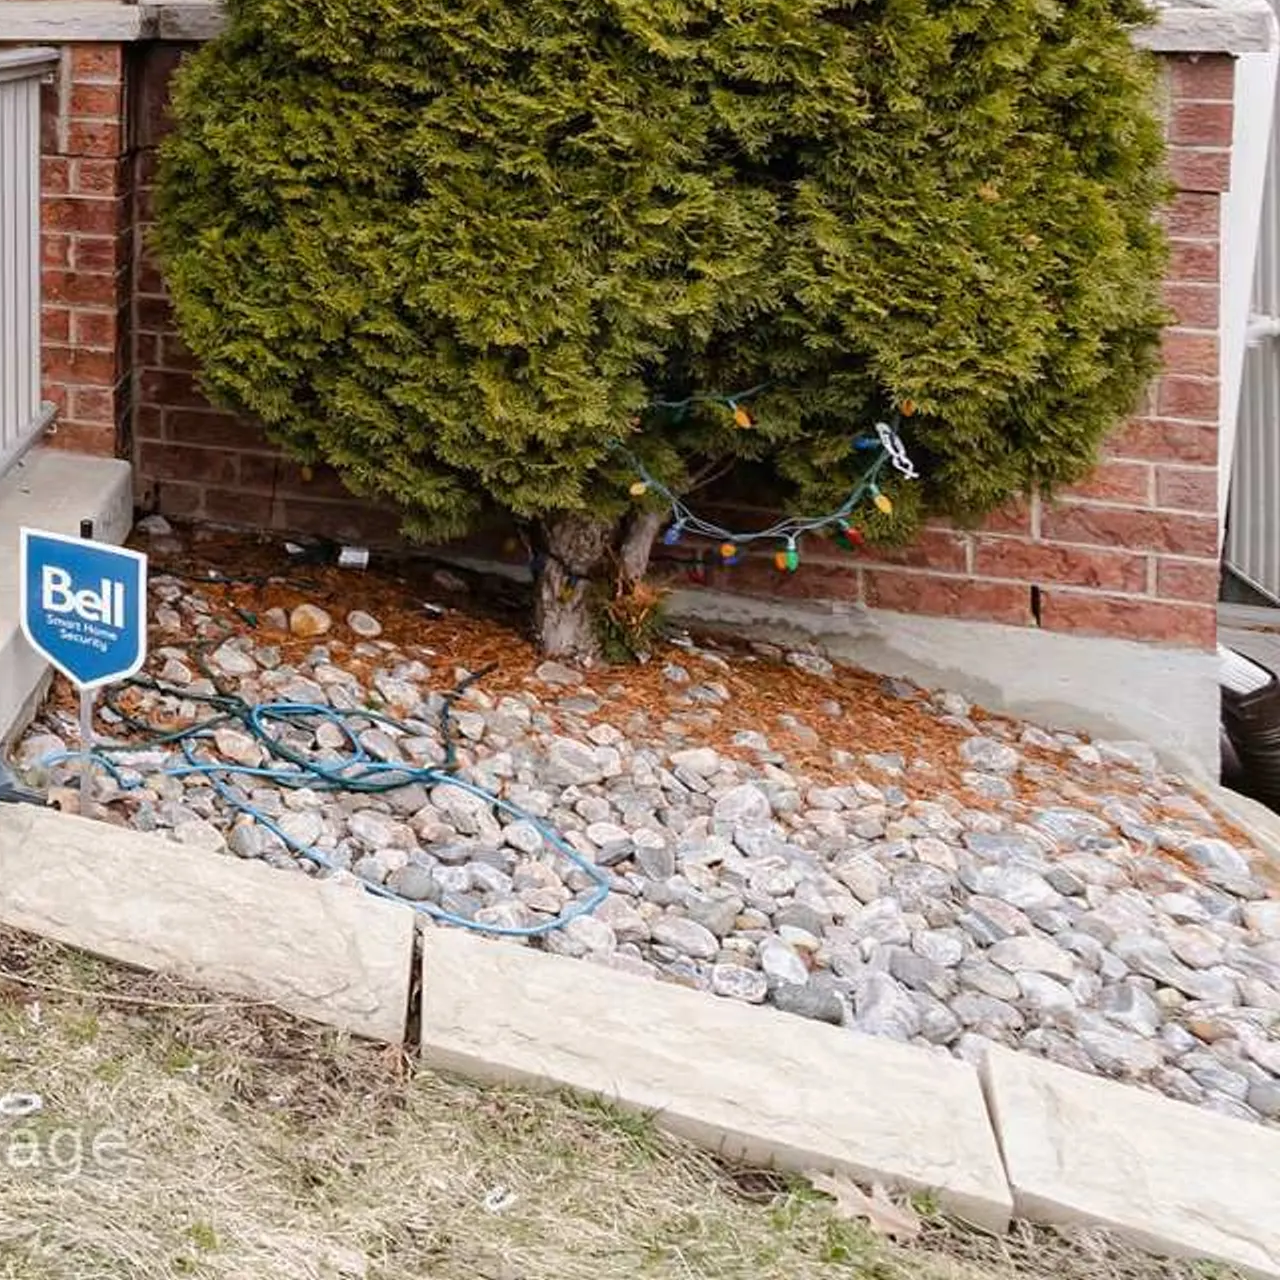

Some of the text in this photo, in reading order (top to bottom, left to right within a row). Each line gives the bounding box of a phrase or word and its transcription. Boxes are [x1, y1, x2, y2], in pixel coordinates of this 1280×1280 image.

[41, 564, 125, 629] Bell
[46, 614, 81, 632] Smart
[60, 628, 108, 653] Security
